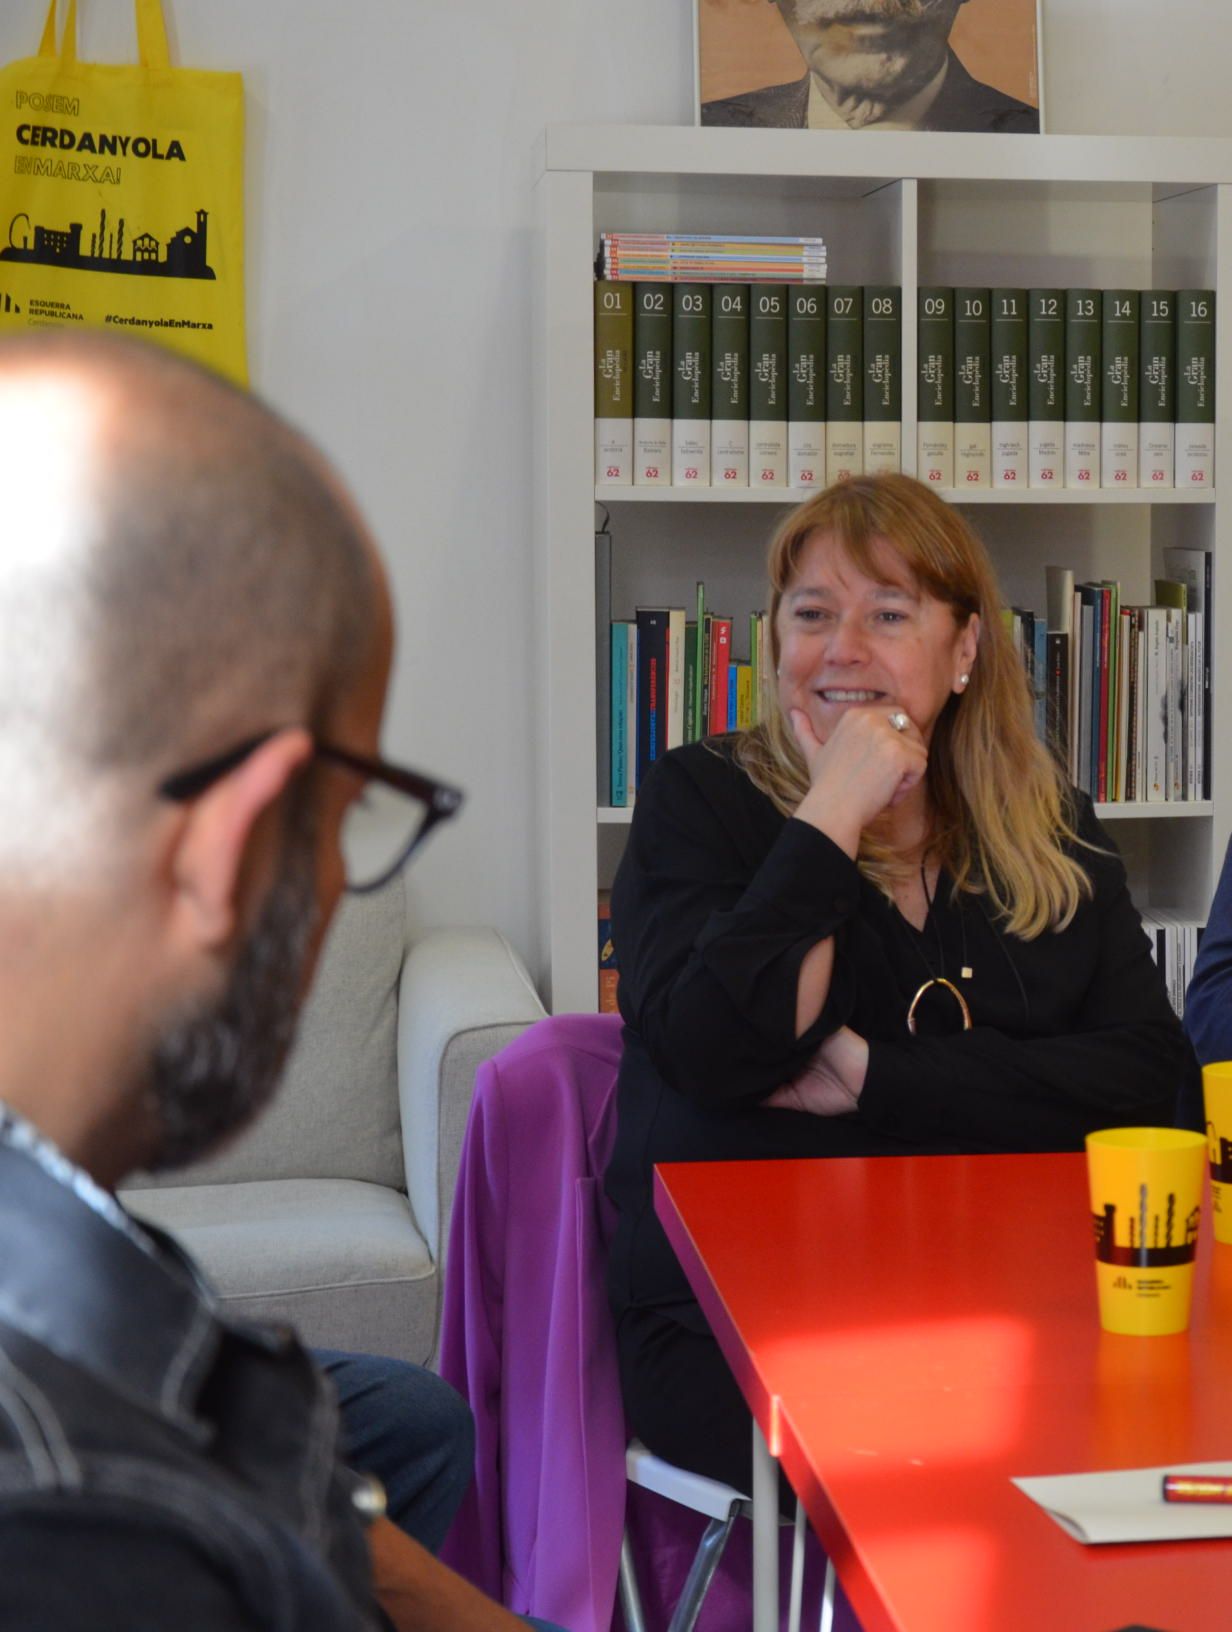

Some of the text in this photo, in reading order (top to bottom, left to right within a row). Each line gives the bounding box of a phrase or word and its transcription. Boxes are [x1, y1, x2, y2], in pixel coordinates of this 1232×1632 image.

[15, 90, 80, 117] POSEM
[16, 123, 187, 162] CERDANYOLA
[29, 299, 71, 310] ESQUERRA
[603, 293, 622, 309] 01
[643, 294, 664, 310] 02
[682, 295, 703, 311] 03
[721, 296, 742, 312] 04
[759, 297, 780, 313] 05
[796, 298, 817, 314] 06
[834, 298, 853, 314] 07
[872, 298, 893, 314] 08
[924, 299, 945, 314] 09
[965, 300, 983, 316] 10
[1001, 299, 1017, 315] 11
[1039, 299, 1057, 315] 12
[1077, 300, 1094, 315] 13
[1114, 301, 1131, 316] 14
[1151, 301, 1169, 316] 15
[28, 308, 84, 320] REPUBLICANA
[1190, 302, 1208, 317] 16
[105, 315, 214, 330] #CerdanyolaEnMarxa
[602, 350, 613, 378] Gran
[642, 351, 653, 379] Gran
[681, 352, 692, 380] Gran
[720, 353, 731, 381] Gran
[758, 354, 769, 382] Gran
[796, 355, 807, 383] Gran
[833, 355, 844, 383] Gran
[871, 355, 882, 383] Gran
[924, 355, 935, 383] Gran
[962, 357, 973, 385] Gran
[999, 356, 1010, 384] Gran
[1037, 355, 1048, 383] Gran
[1074, 356, 1085, 384] Gran
[1110, 357, 1121, 385] Gran
[1148, 357, 1159, 385] Gran
[1187, 357, 1198, 385] Gran
[607, 468, 620, 477] 62
[645, 469, 659, 478] 62
[685, 469, 698, 478] 62
[724, 470, 737, 479] 62
[761, 470, 774, 479] 62
[800, 471, 814, 480] 62
[928, 472, 942, 481] 62
[966, 472, 980, 481] 62
[1003, 471, 1017, 480] 62
[1040, 471, 1054, 480] 62
[1077, 471, 1091, 480] 62
[1114, 471, 1128, 480] 62
[1151, 472, 1165, 481] 62
[1190, 472, 1204, 481] 62
